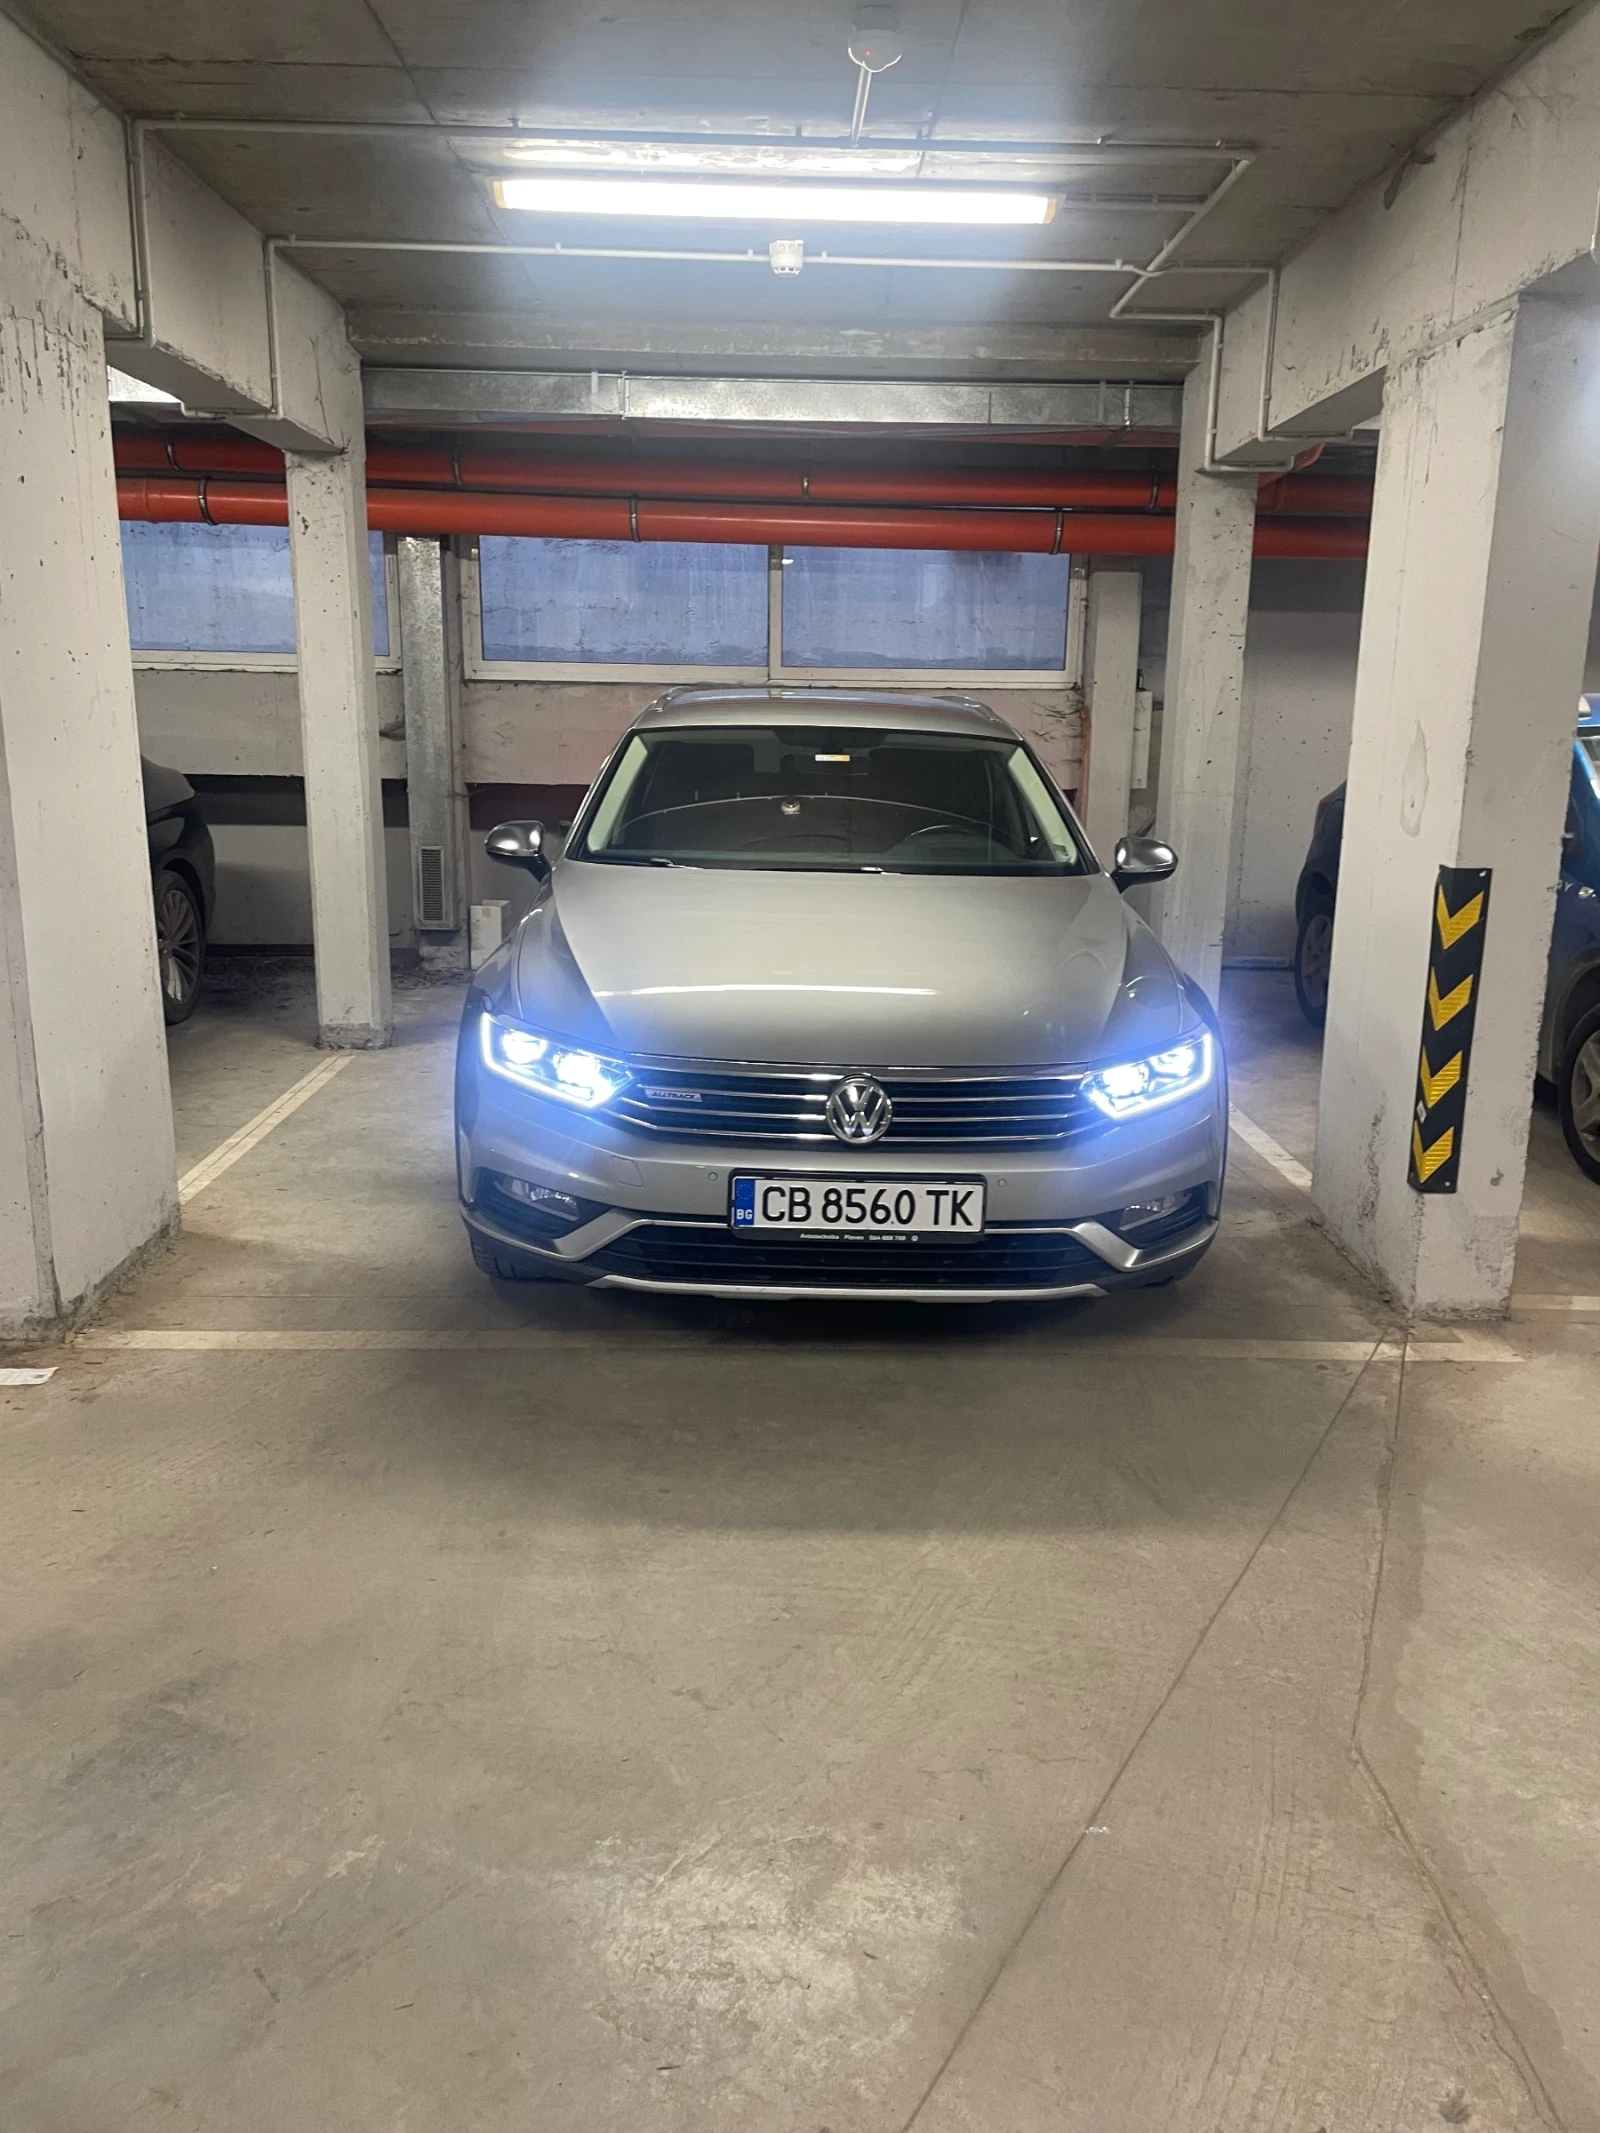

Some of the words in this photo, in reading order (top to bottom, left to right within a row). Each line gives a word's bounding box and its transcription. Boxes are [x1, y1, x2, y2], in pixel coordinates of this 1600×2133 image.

[651, 1091, 696, 1099] ALLTRACK
[762, 1186, 811, 1222] CB
[822, 1188, 915, 1225] 8560
[926, 1190, 974, 1226] TK
[736, 1209, 753, 1220] BG
